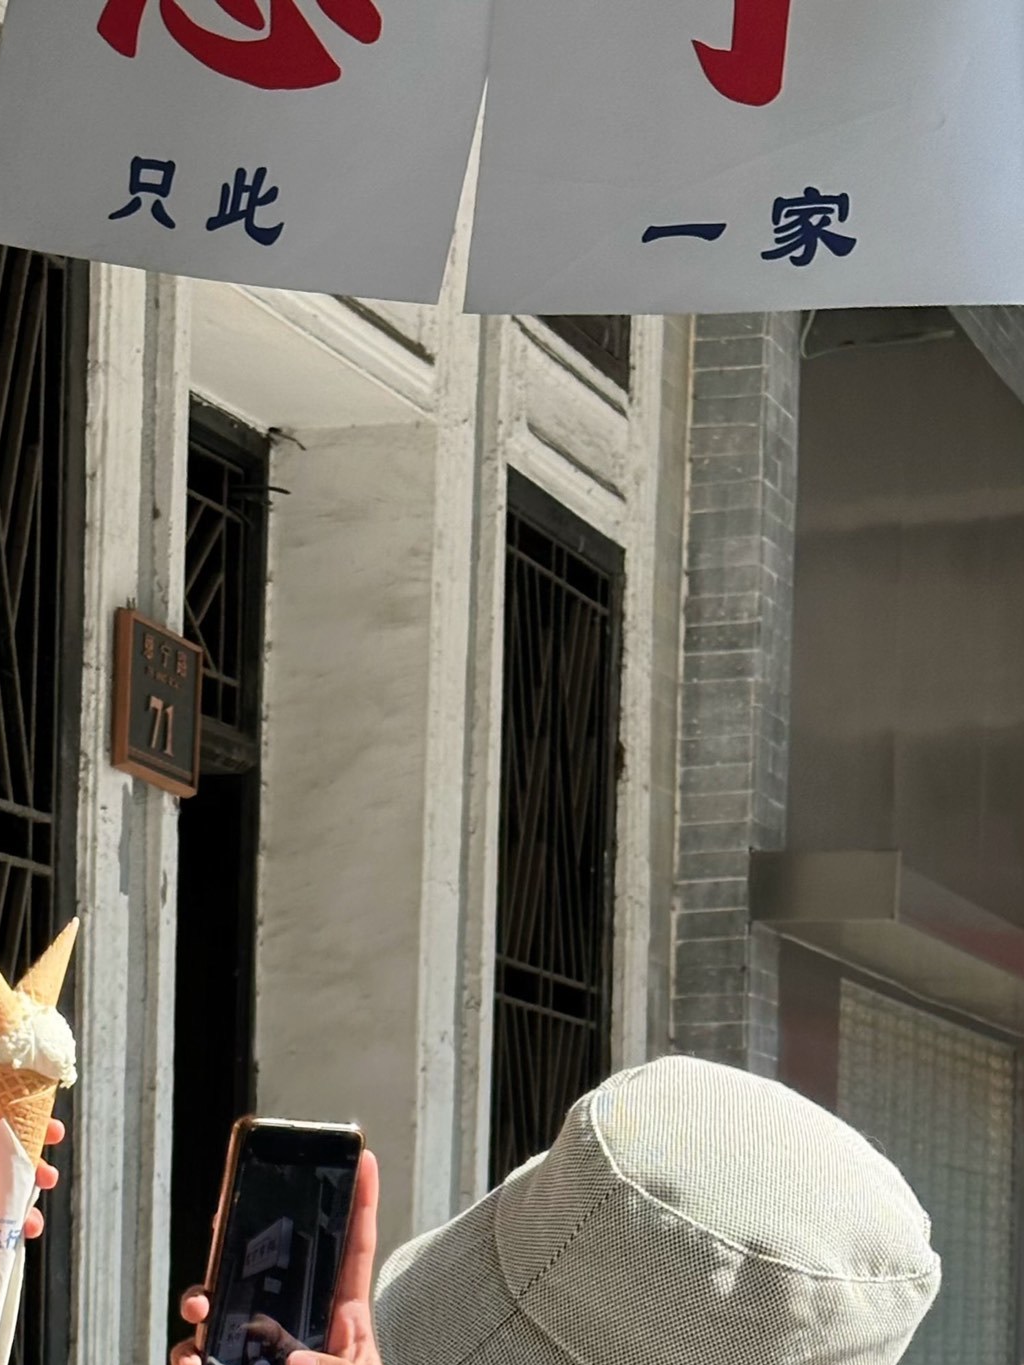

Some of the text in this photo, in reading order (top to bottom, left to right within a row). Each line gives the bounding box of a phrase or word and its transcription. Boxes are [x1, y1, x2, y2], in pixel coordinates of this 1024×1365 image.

[108, 155, 857, 267] 只此 一家
[150, 695, 175, 757] 71
